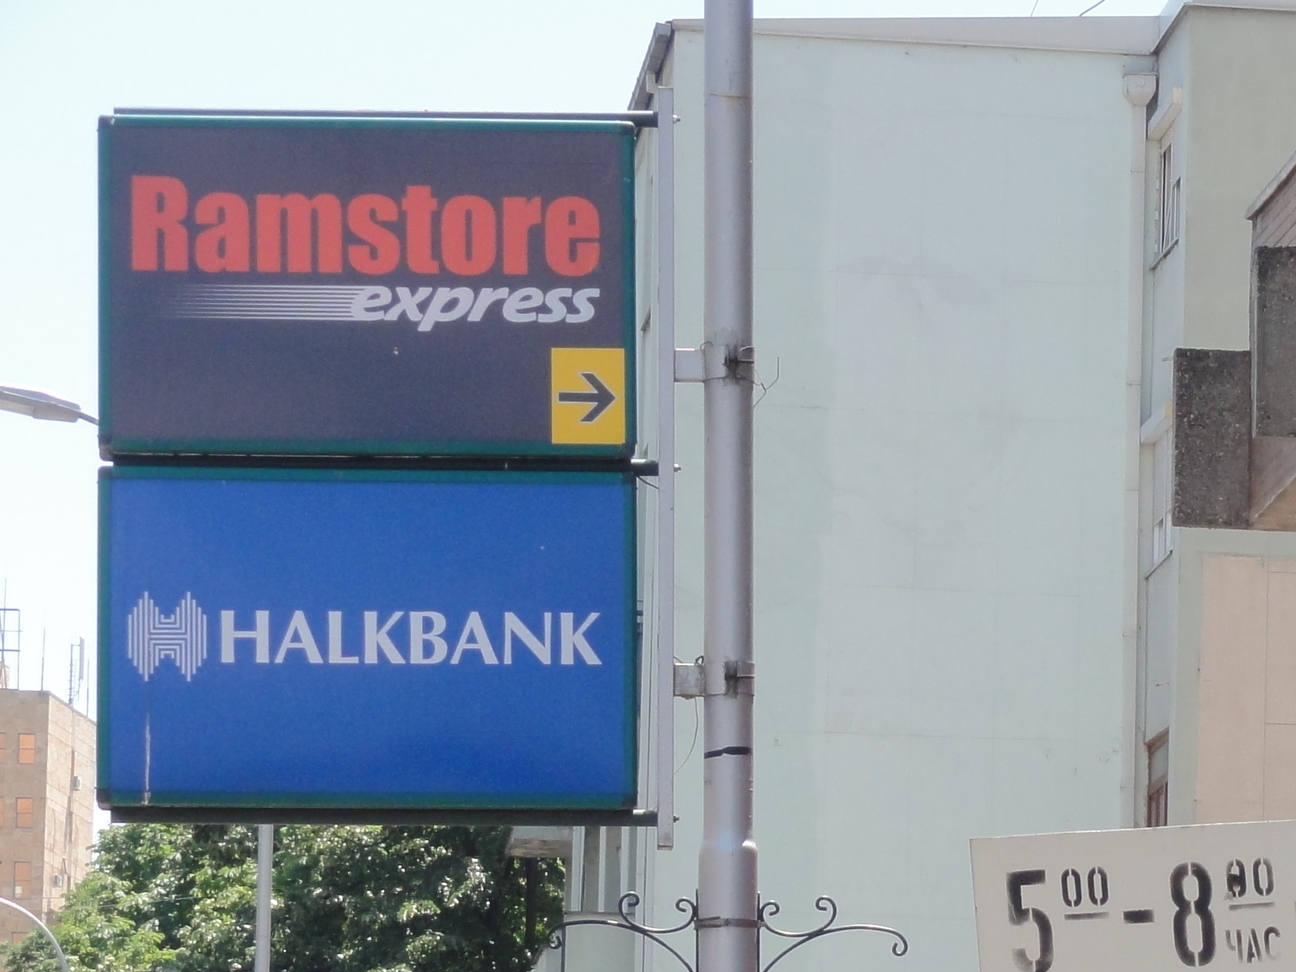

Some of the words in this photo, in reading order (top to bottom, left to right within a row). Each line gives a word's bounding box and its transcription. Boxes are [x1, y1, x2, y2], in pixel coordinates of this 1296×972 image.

[130, 175, 601, 277] Ramstore
[352, 285, 600, 332] express
[220, 609, 603, 666] HALKBANK
